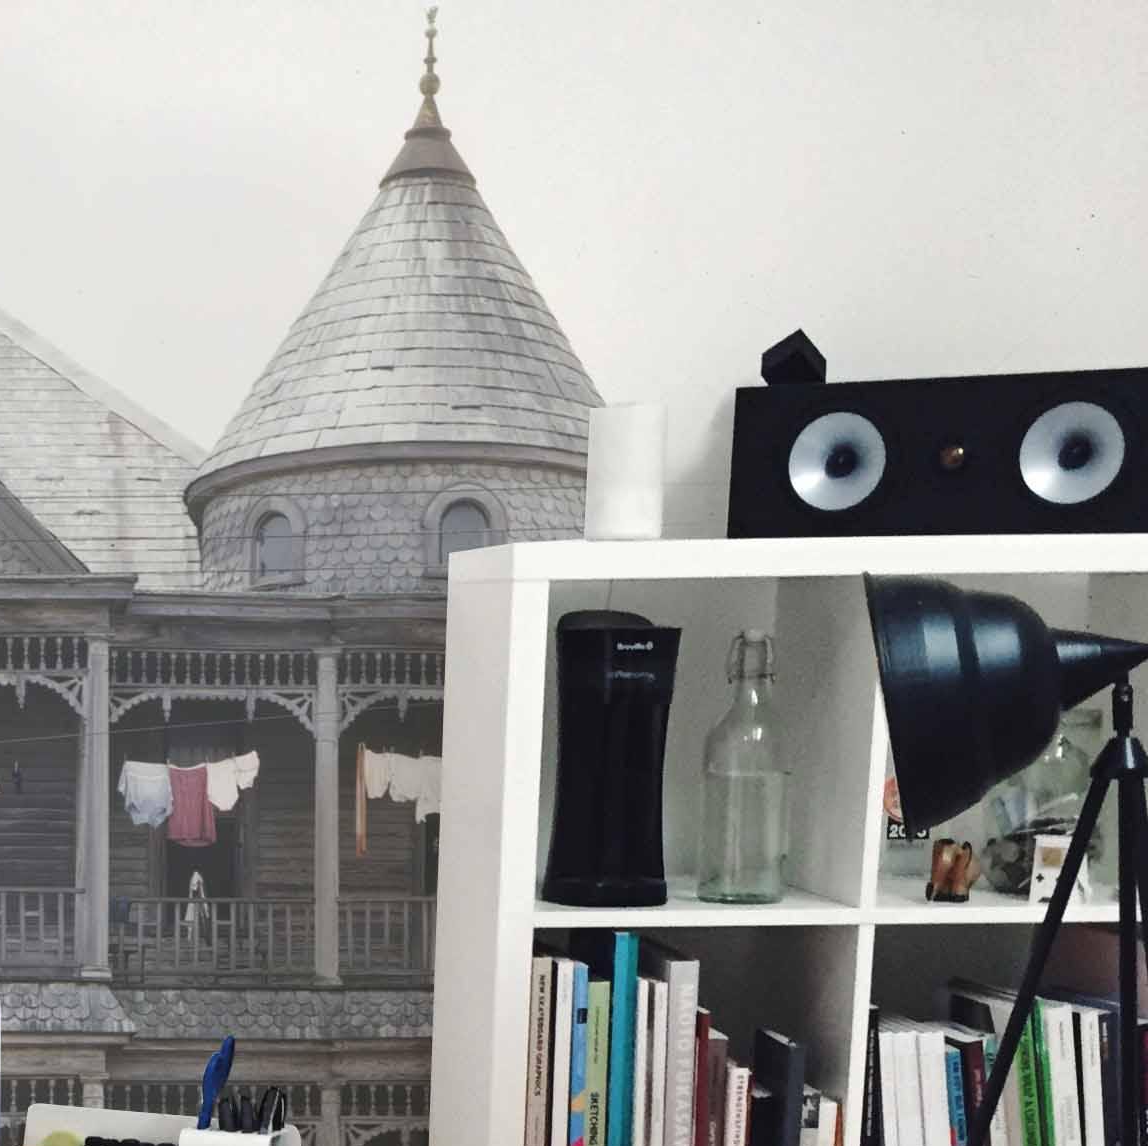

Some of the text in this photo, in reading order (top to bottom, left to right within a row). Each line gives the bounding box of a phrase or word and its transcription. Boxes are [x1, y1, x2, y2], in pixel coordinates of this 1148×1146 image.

[535, 995, 545, 1052] SKATEBOARD
[679, 983, 694, 1048] NAOTO
[533, 1053, 544, 1097] GRAPHICS
[588, 1091, 600, 1146] SKETCHING
